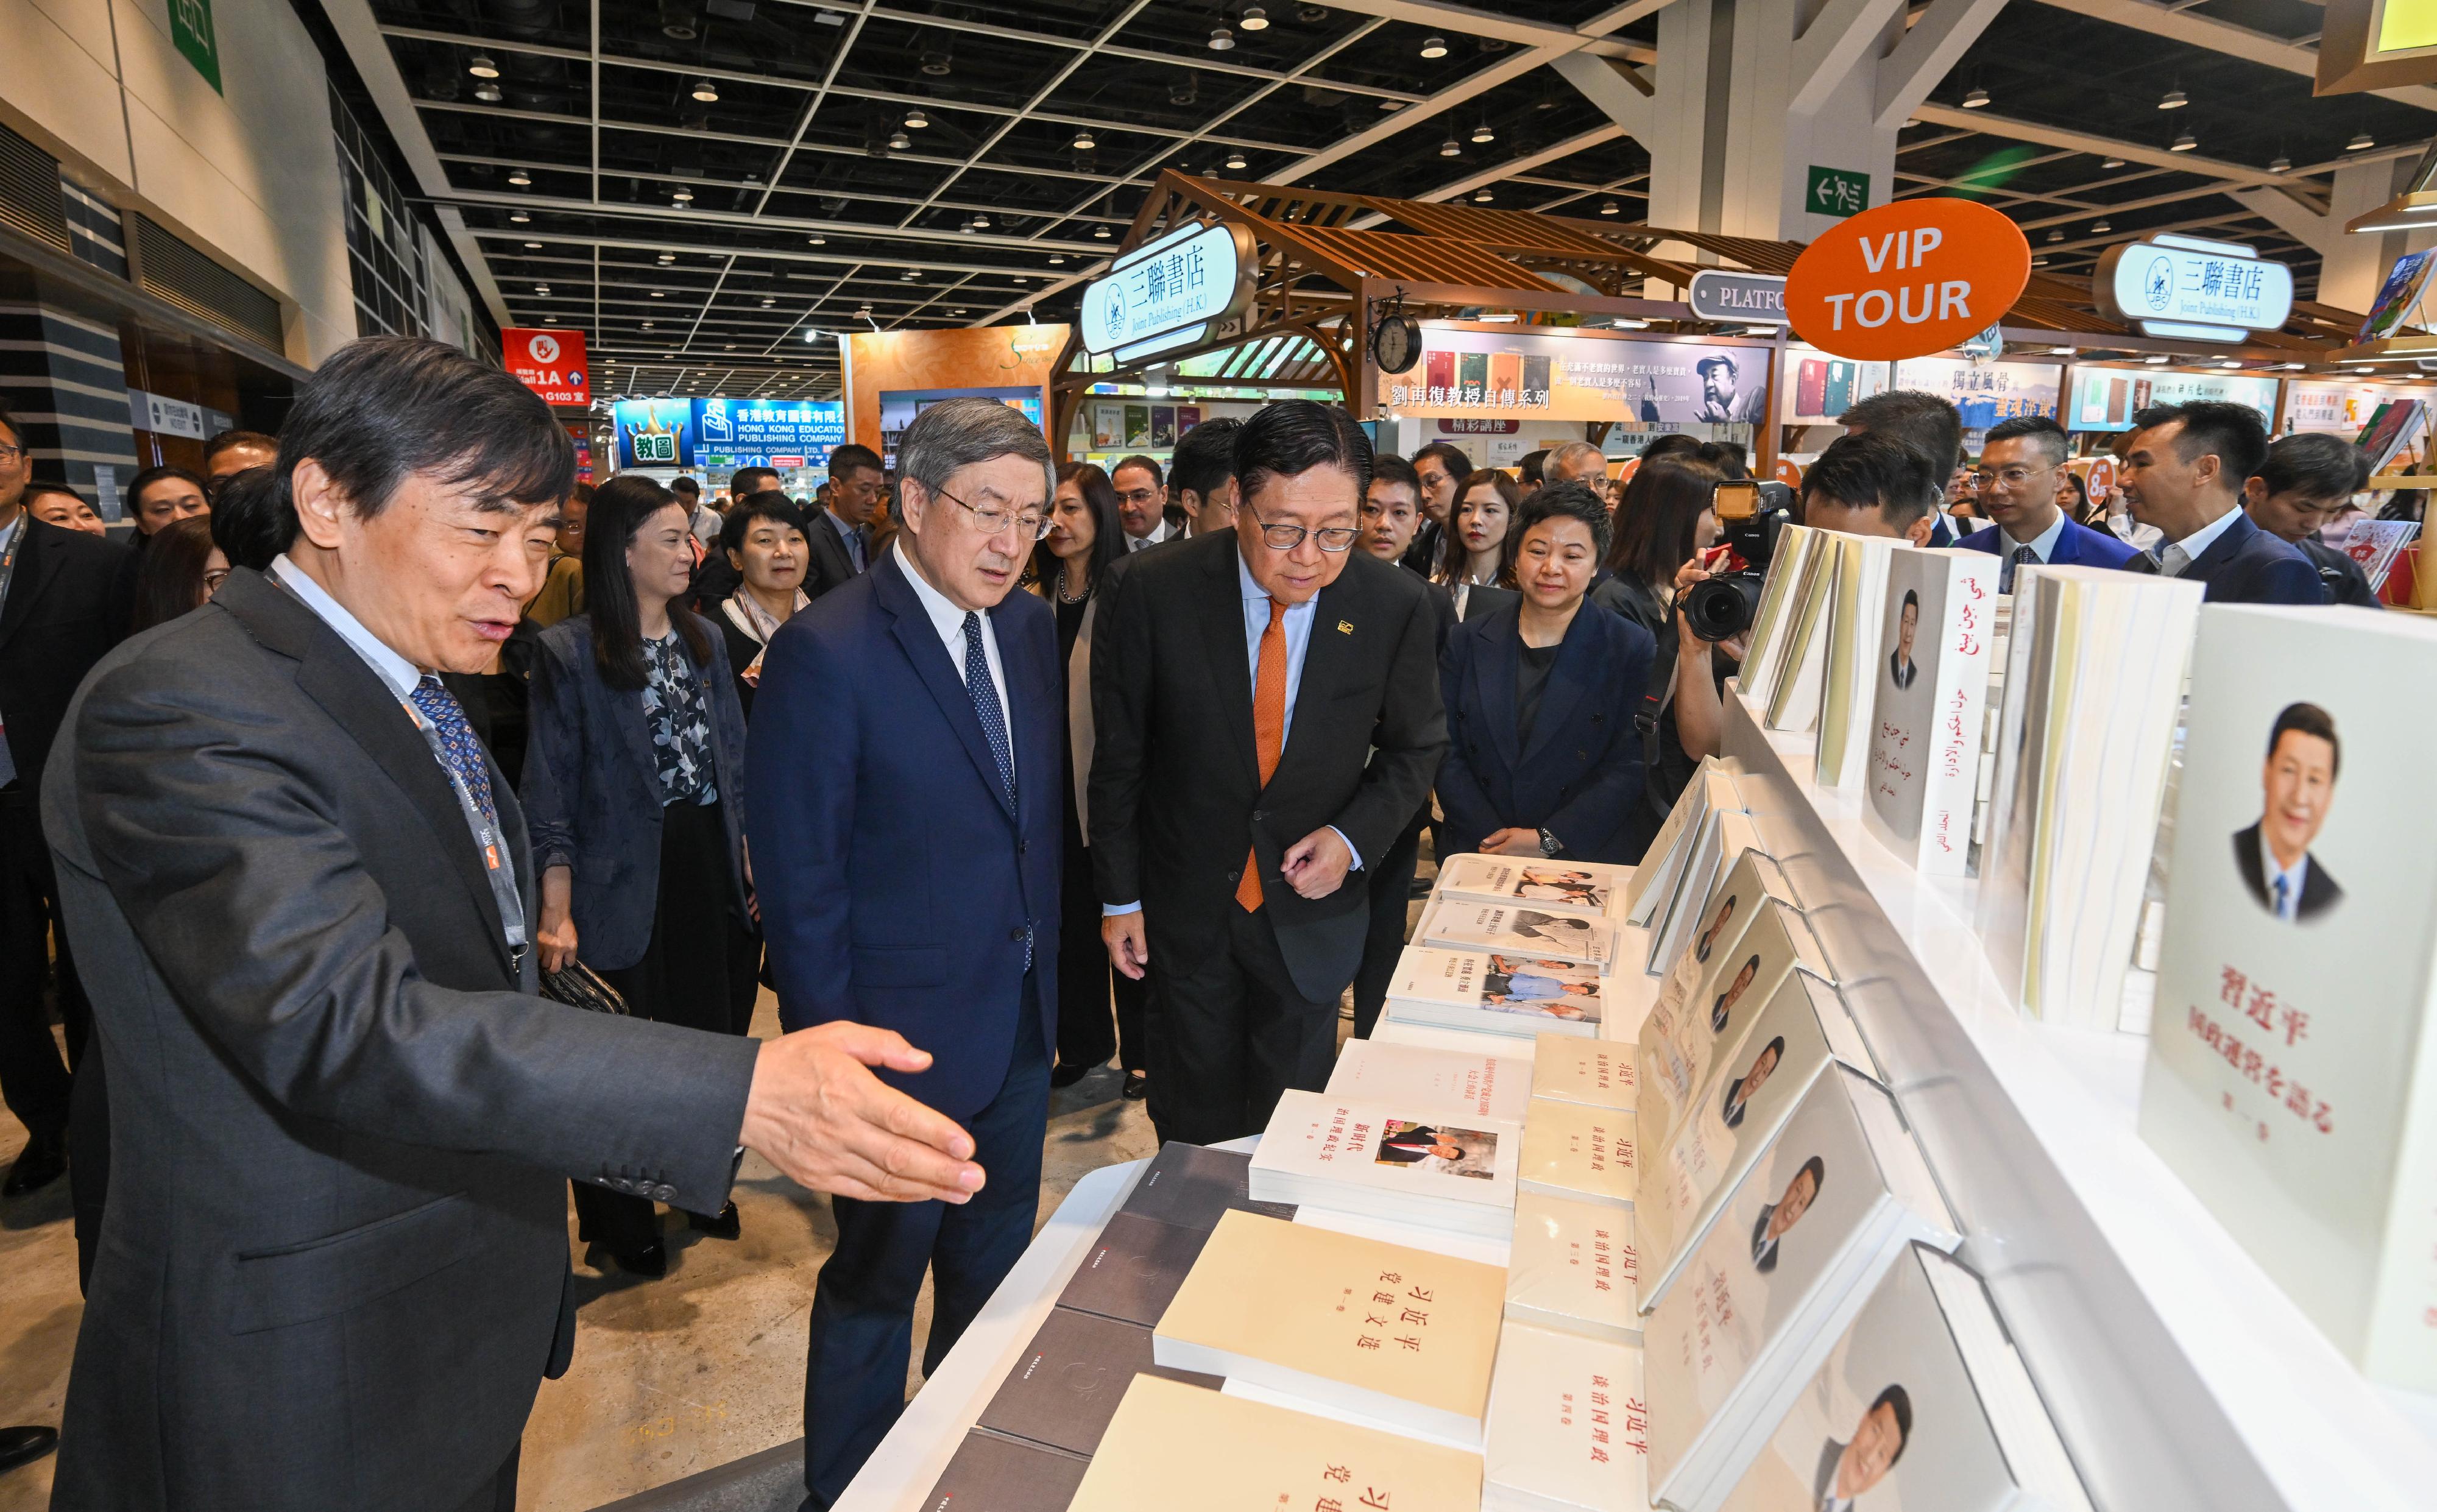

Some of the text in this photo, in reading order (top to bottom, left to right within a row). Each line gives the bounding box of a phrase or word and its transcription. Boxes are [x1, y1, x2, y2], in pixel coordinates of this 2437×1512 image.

[1858, 227, 1942, 274] VIP
[1131, 245, 1204, 309] 三聯書店
[2181, 261, 2264, 300] 三聯書店
[1131, 293, 1207, 336] Joint Publishing (H.K.)
[1824, 280, 1971, 331] TOUR
[2180, 299, 2198, 316] Joint
[2200, 301, 2237, 322] Publishing
[1109, 322, 1122, 333] JPC
[537, 370, 562, 386] 1A
[1952, 370, 2009, 392] 獨立風骨
[545, 392, 571, 401] G103
[1391, 385, 1549, 410] 劉再復教授自傳系列
[738, 425, 765, 433] HONG
[769, 425, 795, 433] KONG
[738, 434, 796, 443] PUBLISHING
[636, 436, 673, 459] 教圖
[1960, 576, 1986, 600] شي
[1958, 603, 1977, 629] جين
[2220, 963, 2310, 1047] 習近平
[1463, 1069, 1479, 1100] 大会上的讲话
[1597, 1053, 1610, 1089] 谈治国理政
[1618, 1062, 1634, 1086] 习近平
[1318, 1108, 1349, 1161] 治国理政纪实
[1346, 1123, 1371, 1151] 新时代
[1570, 1135, 1579, 1153] 第二卷
[1591, 1126, 1605, 1171] 谈治国理政
[1616, 1138, 1633, 1168] 习近平
[1569, 1242, 1580, 1265] 第三卷
[1594, 1229, 1611, 1292] 谈治国理政
[1335, 1287, 1353, 1313] 第一卷
[1357, 1270, 1402, 1351] 党建文选
[1393, 1286, 1434, 1353] 习近平
[1560, 1392, 1574, 1426] 第四卷
[1590, 1374, 1610, 1464] 谈治国理政
[1625, 1397, 1647, 1455] 习近平
[1315, 1462, 1352, 1512] 党建
